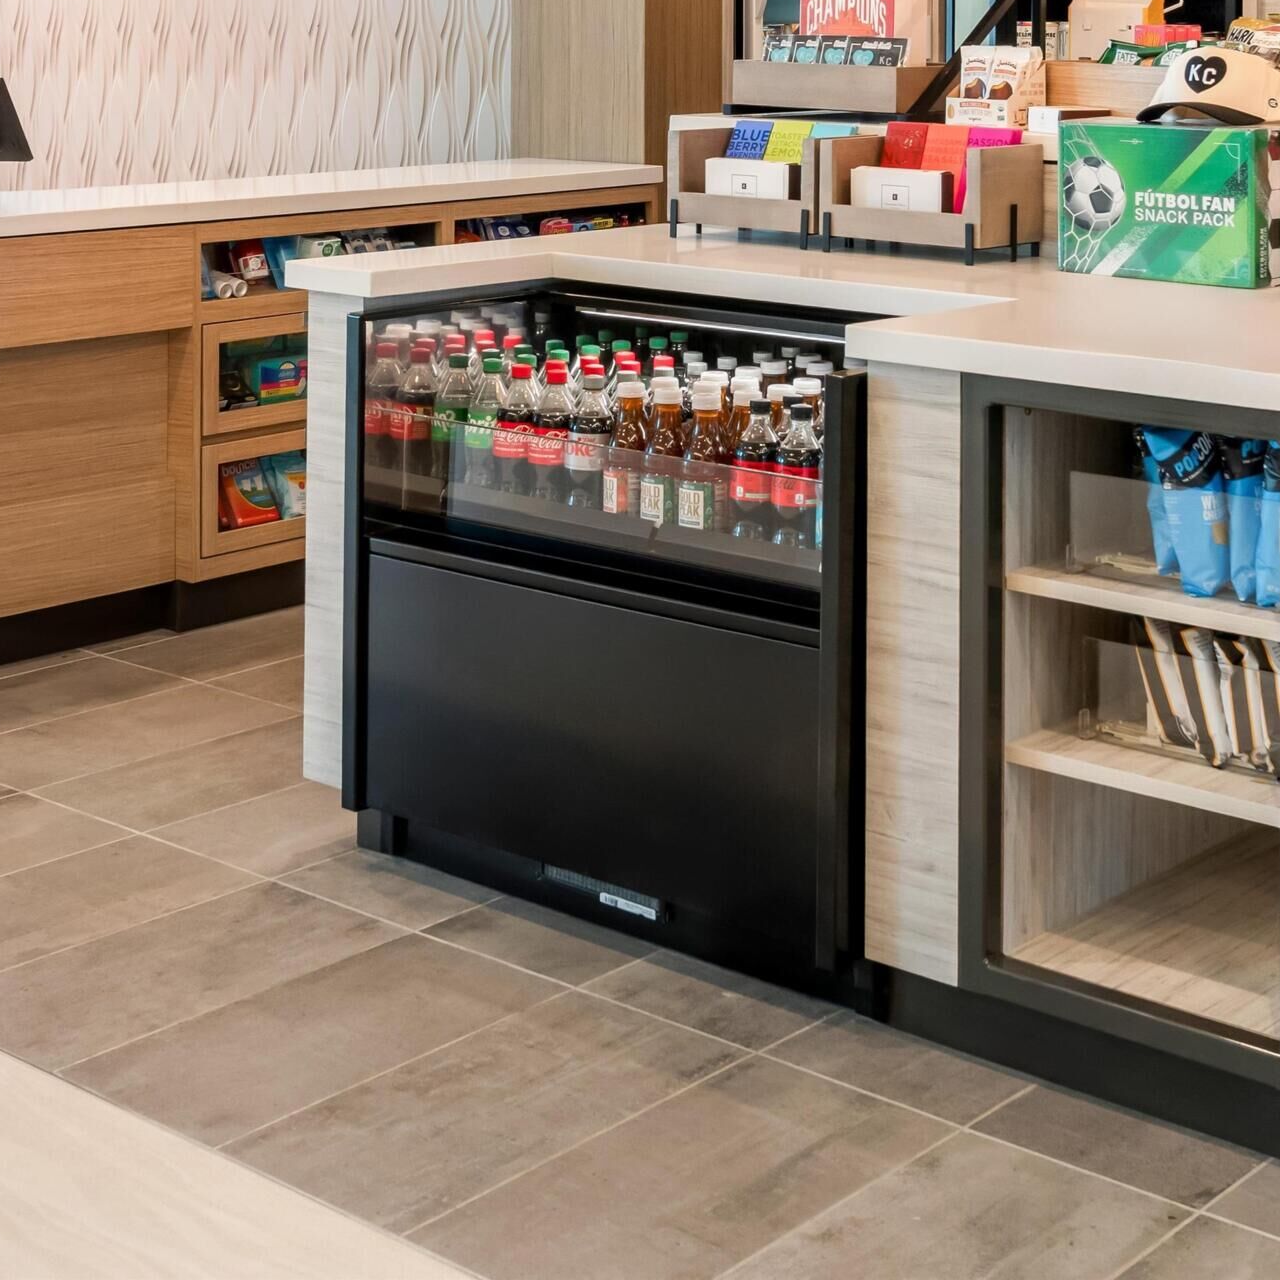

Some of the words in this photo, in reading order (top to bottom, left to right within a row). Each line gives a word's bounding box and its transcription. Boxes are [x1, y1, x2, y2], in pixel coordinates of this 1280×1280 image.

[879, 56, 892, 66] KC
[1187, 63, 1218, 86] KC
[732, 128, 771, 141] BLUE
[728, 141, 766, 152] BERRY
[1135, 189, 1199, 210] FÚTBOL
[1202, 196, 1235, 212] FAN
[1135, 208, 1188, 224] SNACK
[1193, 212, 1235, 227] PACK
[222, 461, 257, 477] bounce
